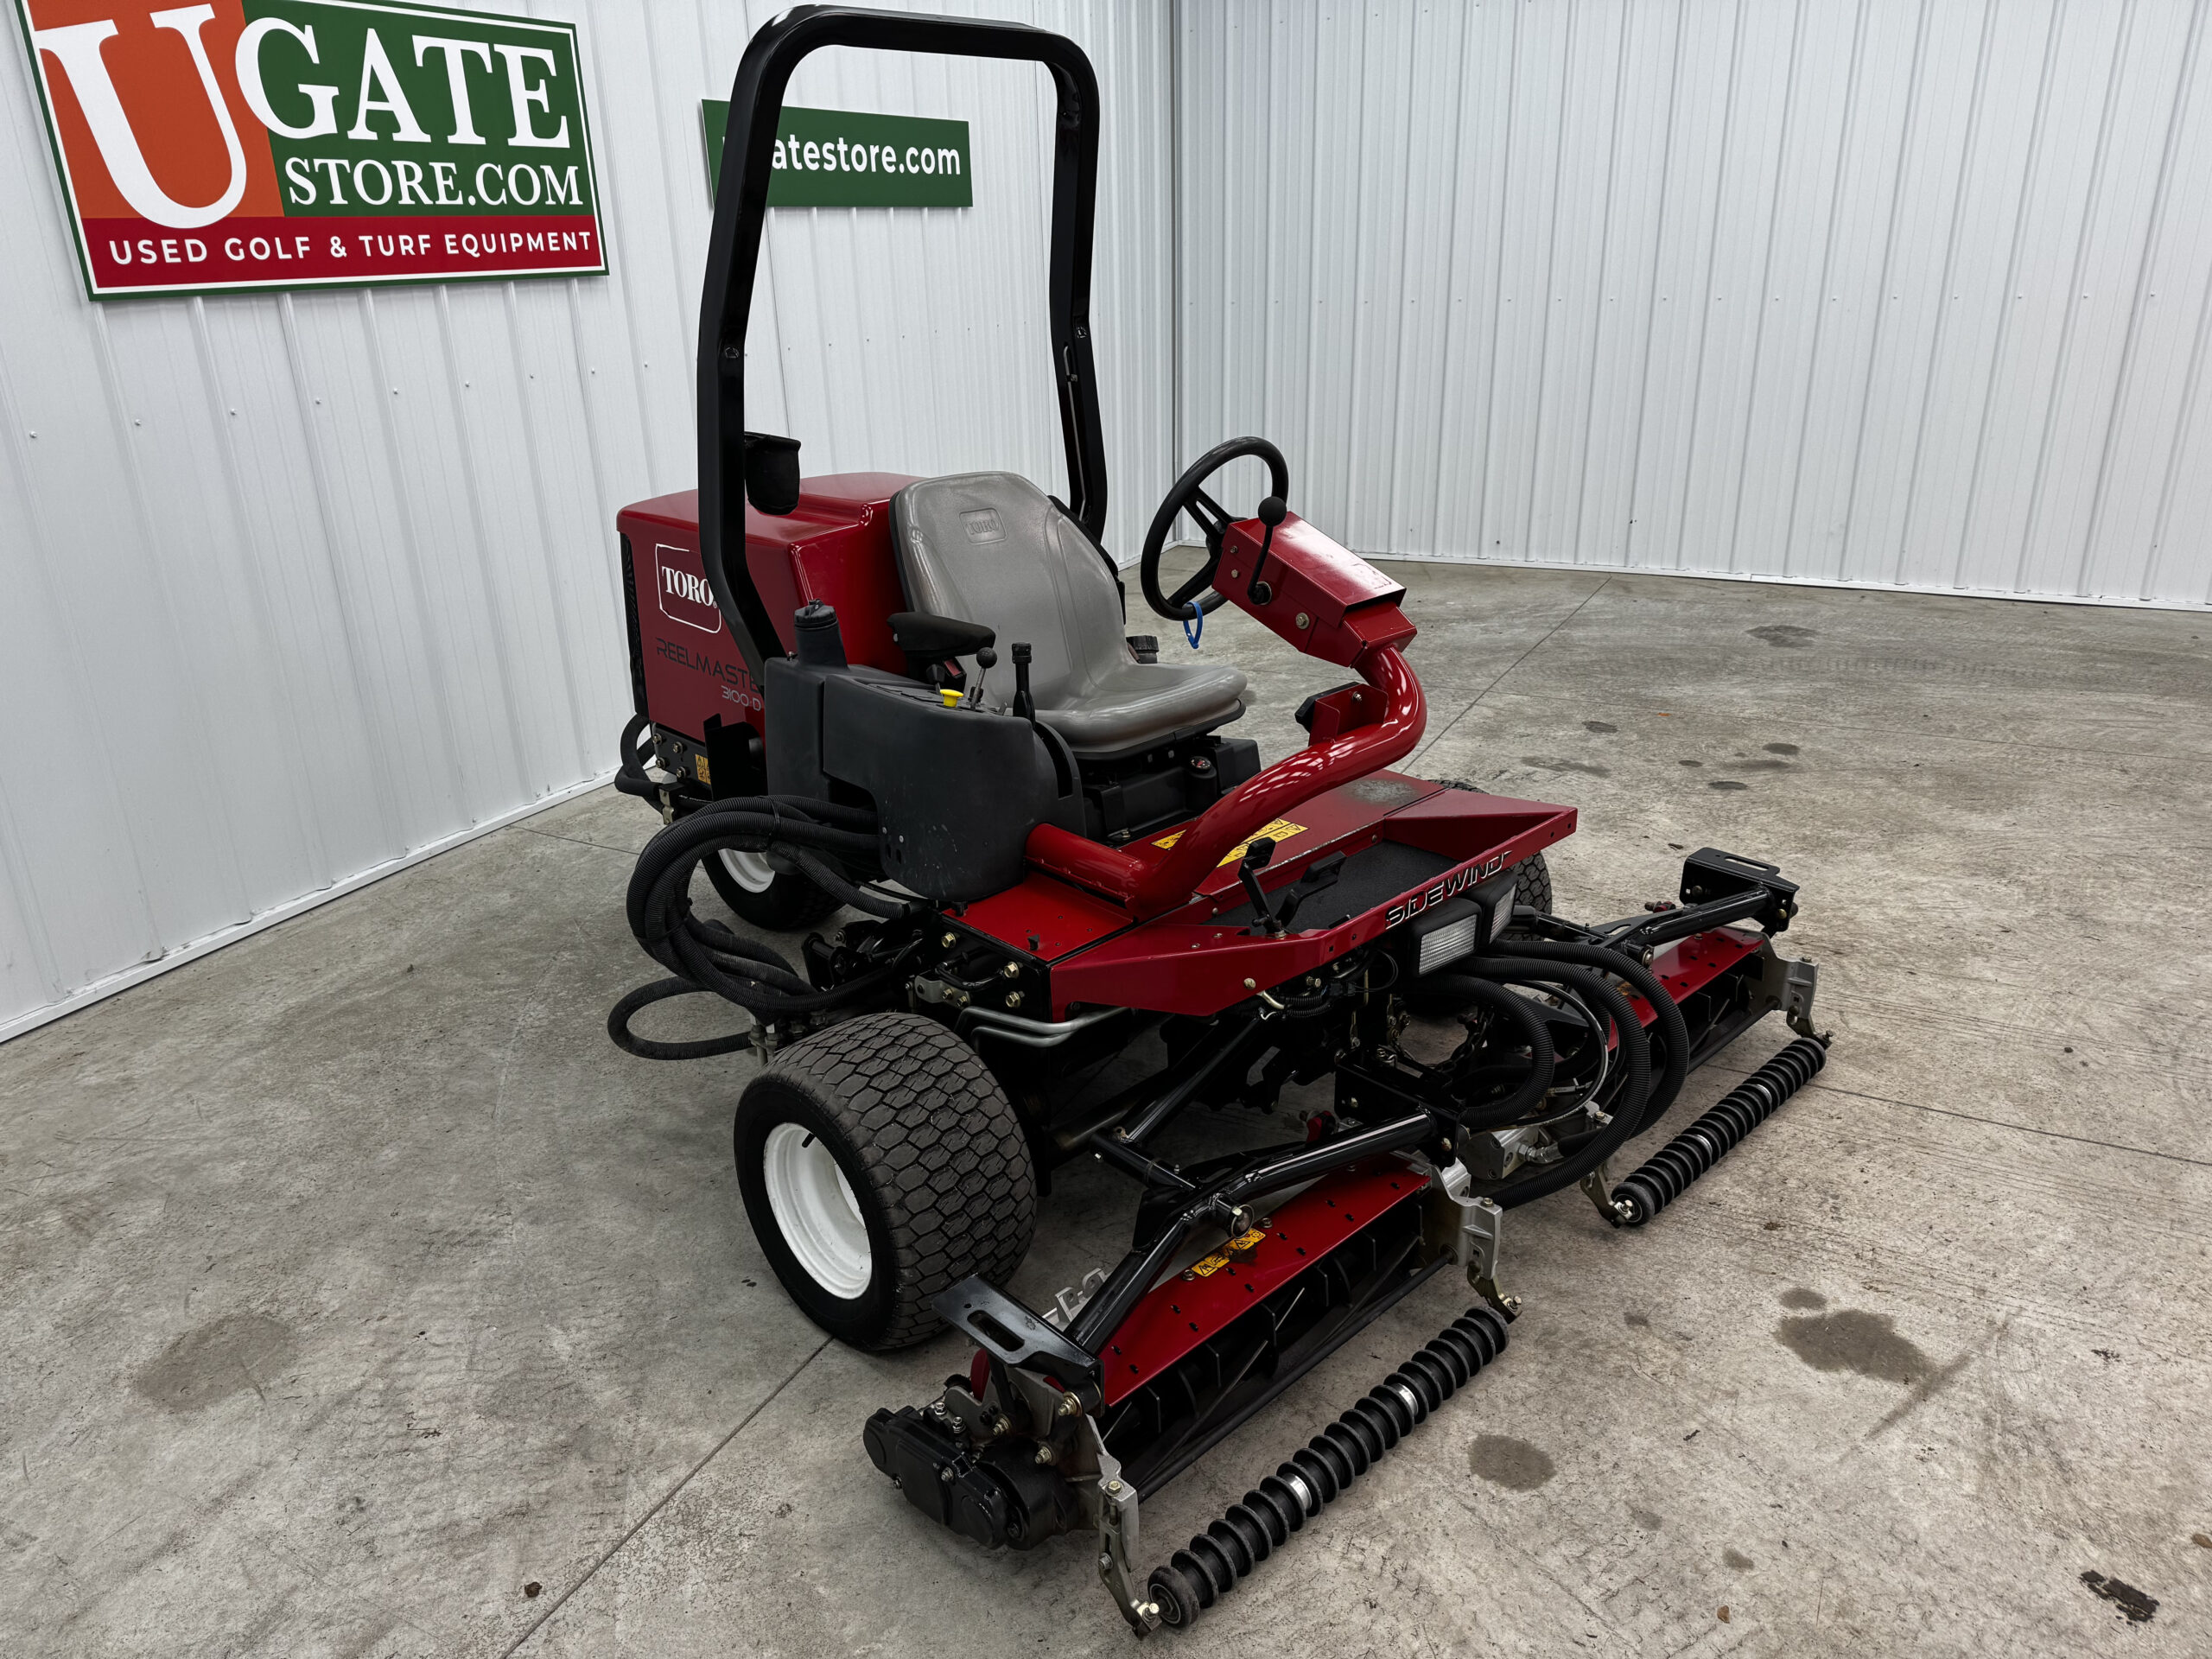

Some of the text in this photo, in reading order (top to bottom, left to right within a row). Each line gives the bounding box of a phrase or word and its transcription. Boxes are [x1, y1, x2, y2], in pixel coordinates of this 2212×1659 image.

[722, 133, 961, 175] atestore.com
[284, 156, 583, 206] STORE.COM
[109, 231, 591, 265] USED GOLF & TURF EQUIPMENT
